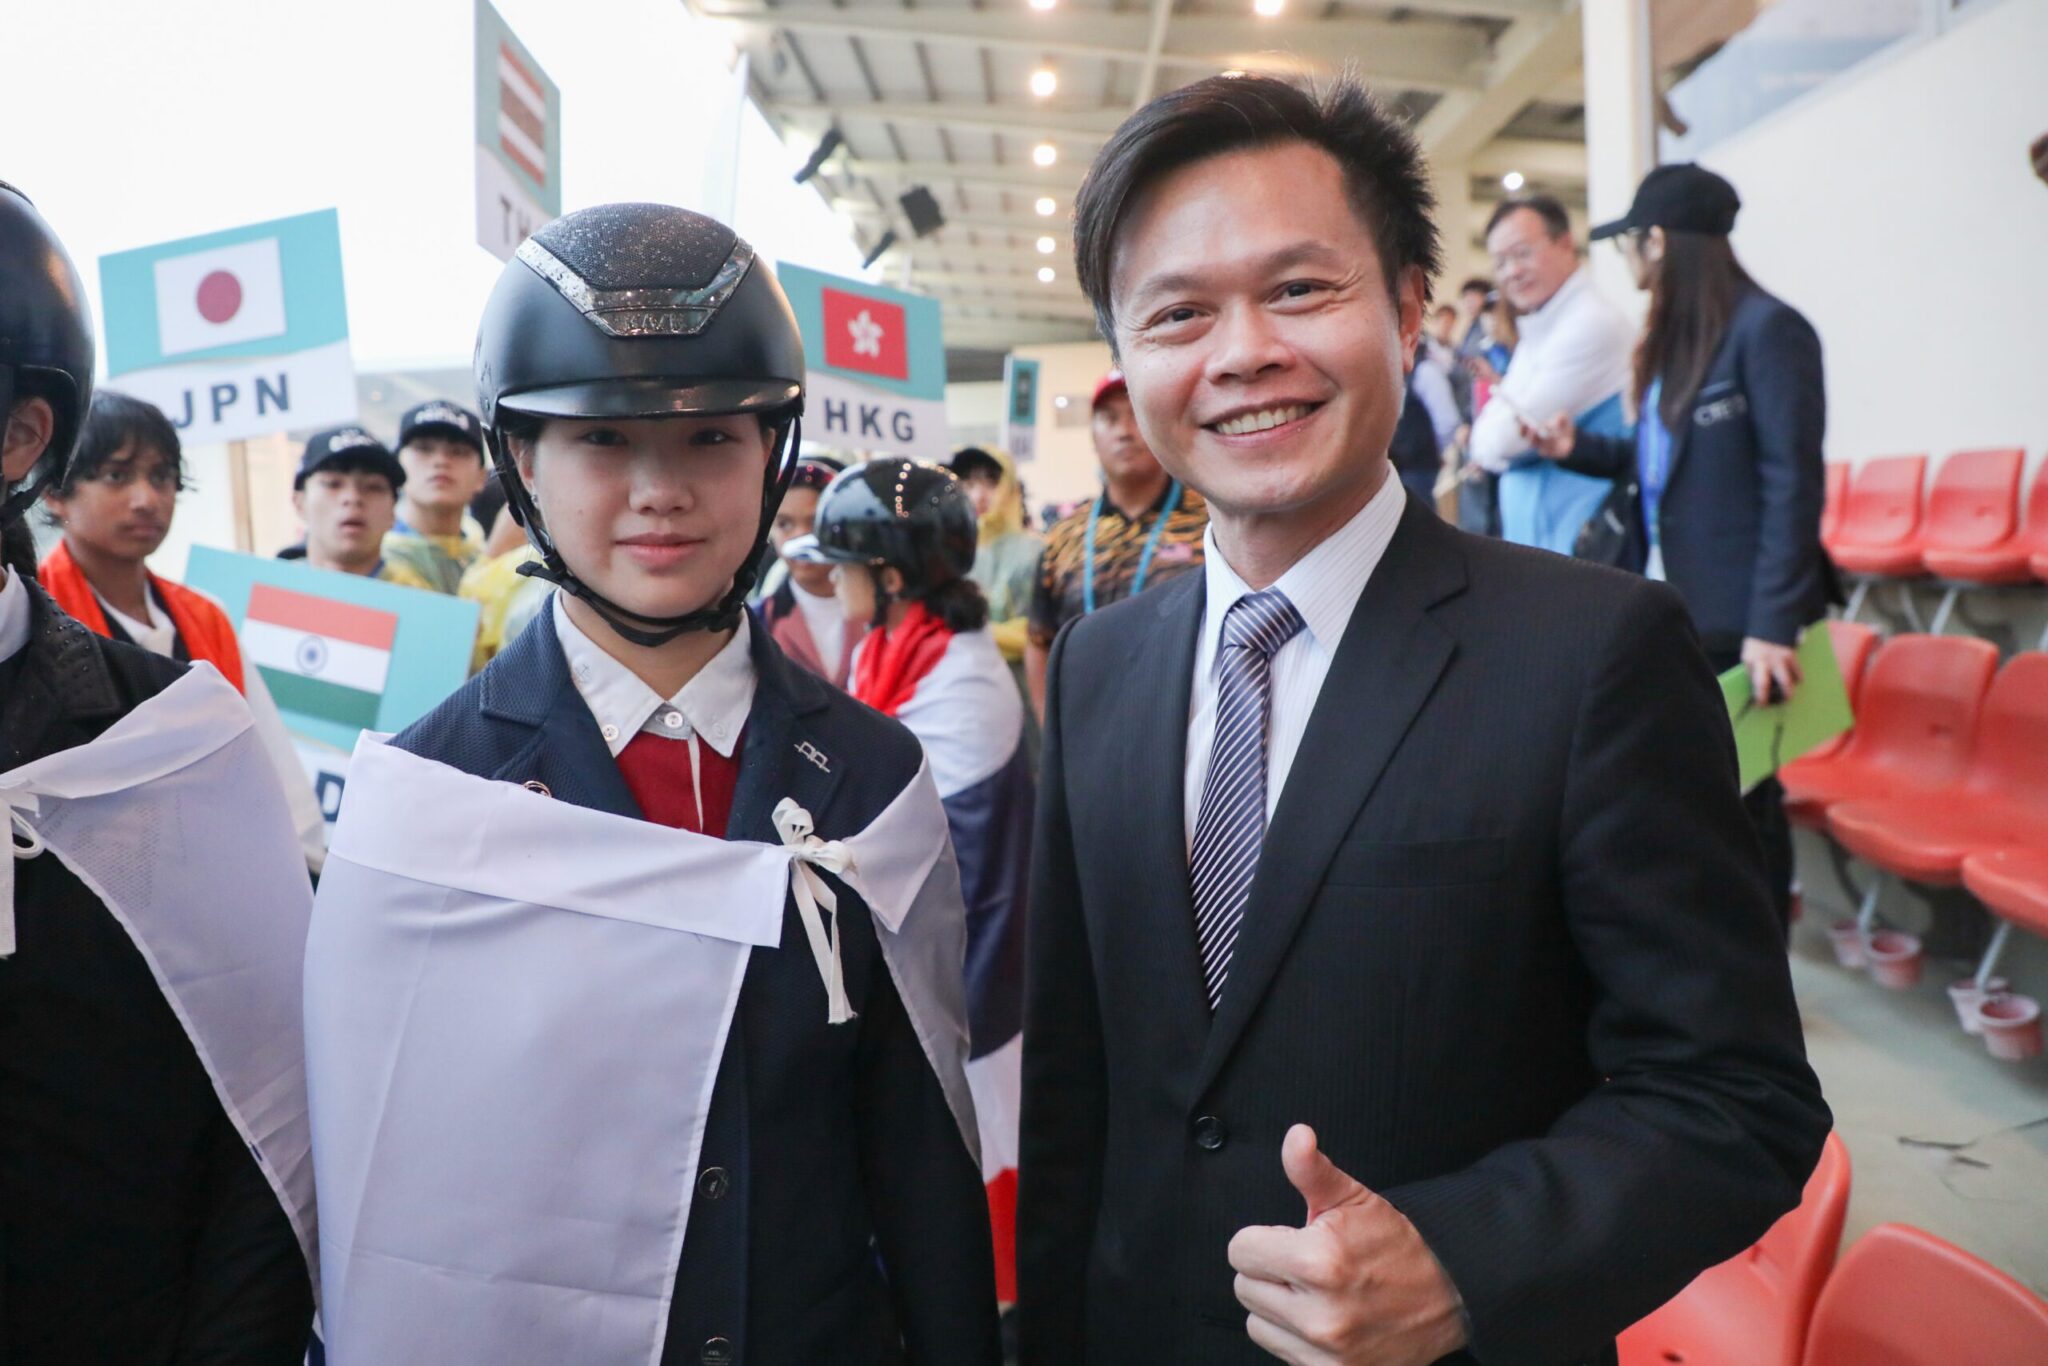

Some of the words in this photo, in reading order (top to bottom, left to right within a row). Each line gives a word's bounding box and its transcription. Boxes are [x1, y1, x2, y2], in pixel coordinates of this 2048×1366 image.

[500, 193, 532, 247] TH
[173, 372, 289, 429] JPN
[824, 397, 914, 443] HKG
